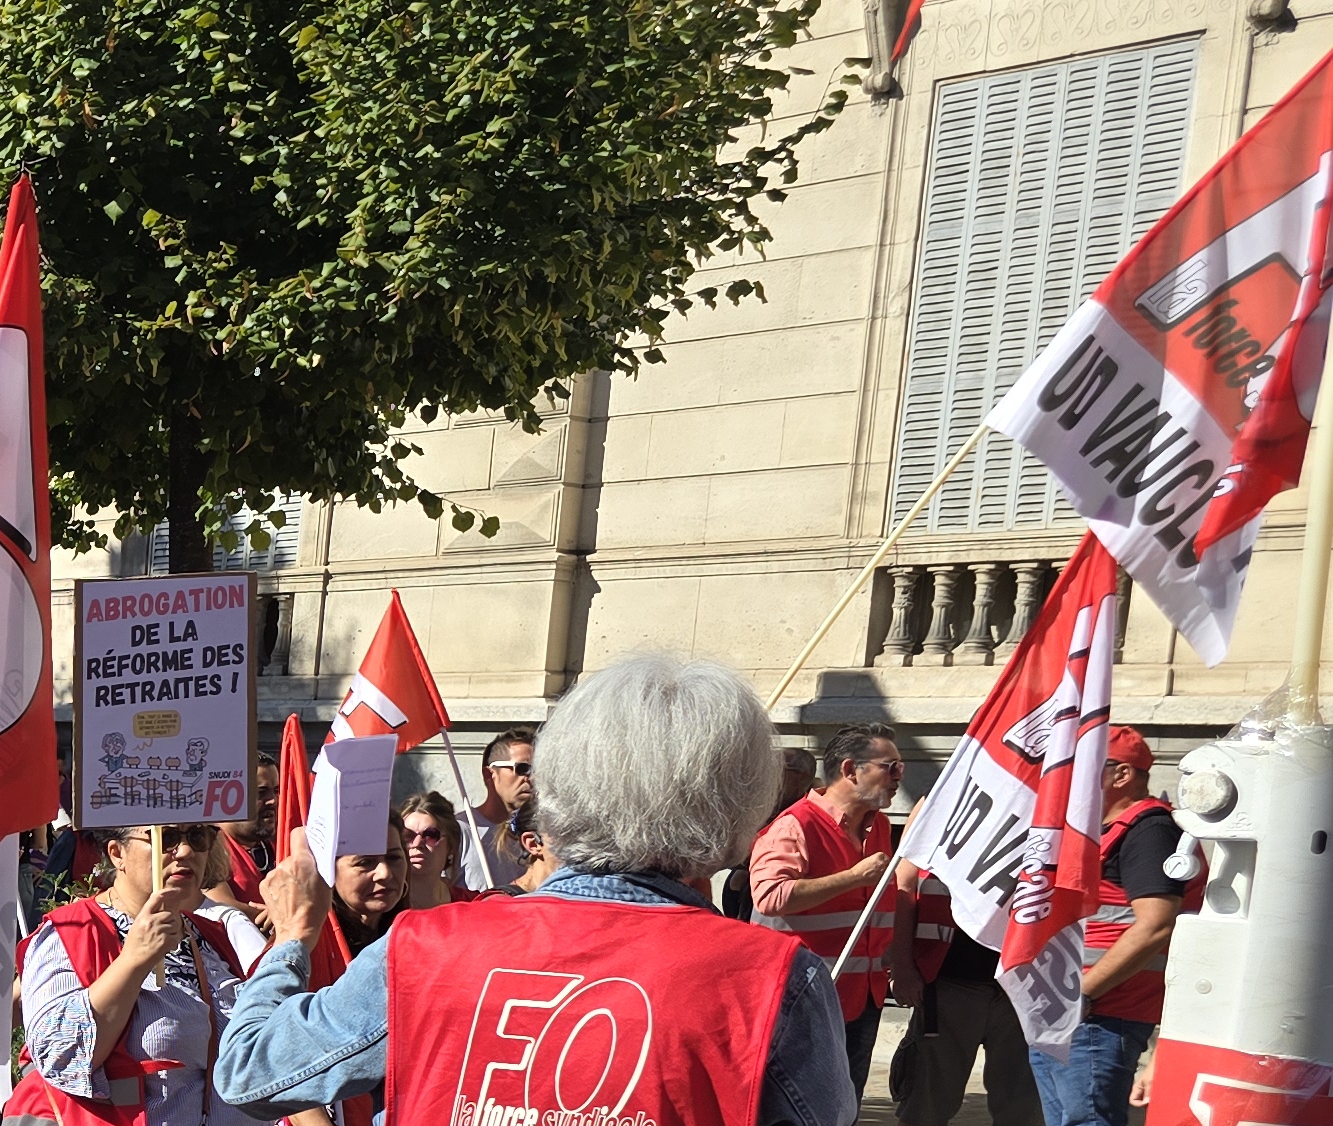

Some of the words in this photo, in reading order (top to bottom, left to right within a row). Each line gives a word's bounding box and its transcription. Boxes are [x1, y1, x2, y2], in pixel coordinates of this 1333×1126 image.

[1183, 298, 1276, 389] force
[1037, 334, 1119, 432] UD
[86, 584, 244, 623] ABROGATION
[131, 622, 160, 647] DE
[168, 619, 198, 643] LA
[86, 649, 194, 680] RÉFORME
[202, 643, 245, 668] DES
[95, 673, 222, 707] RETRAITES
[231, 672, 239, 694] !
[203, 779, 245, 817] FO
